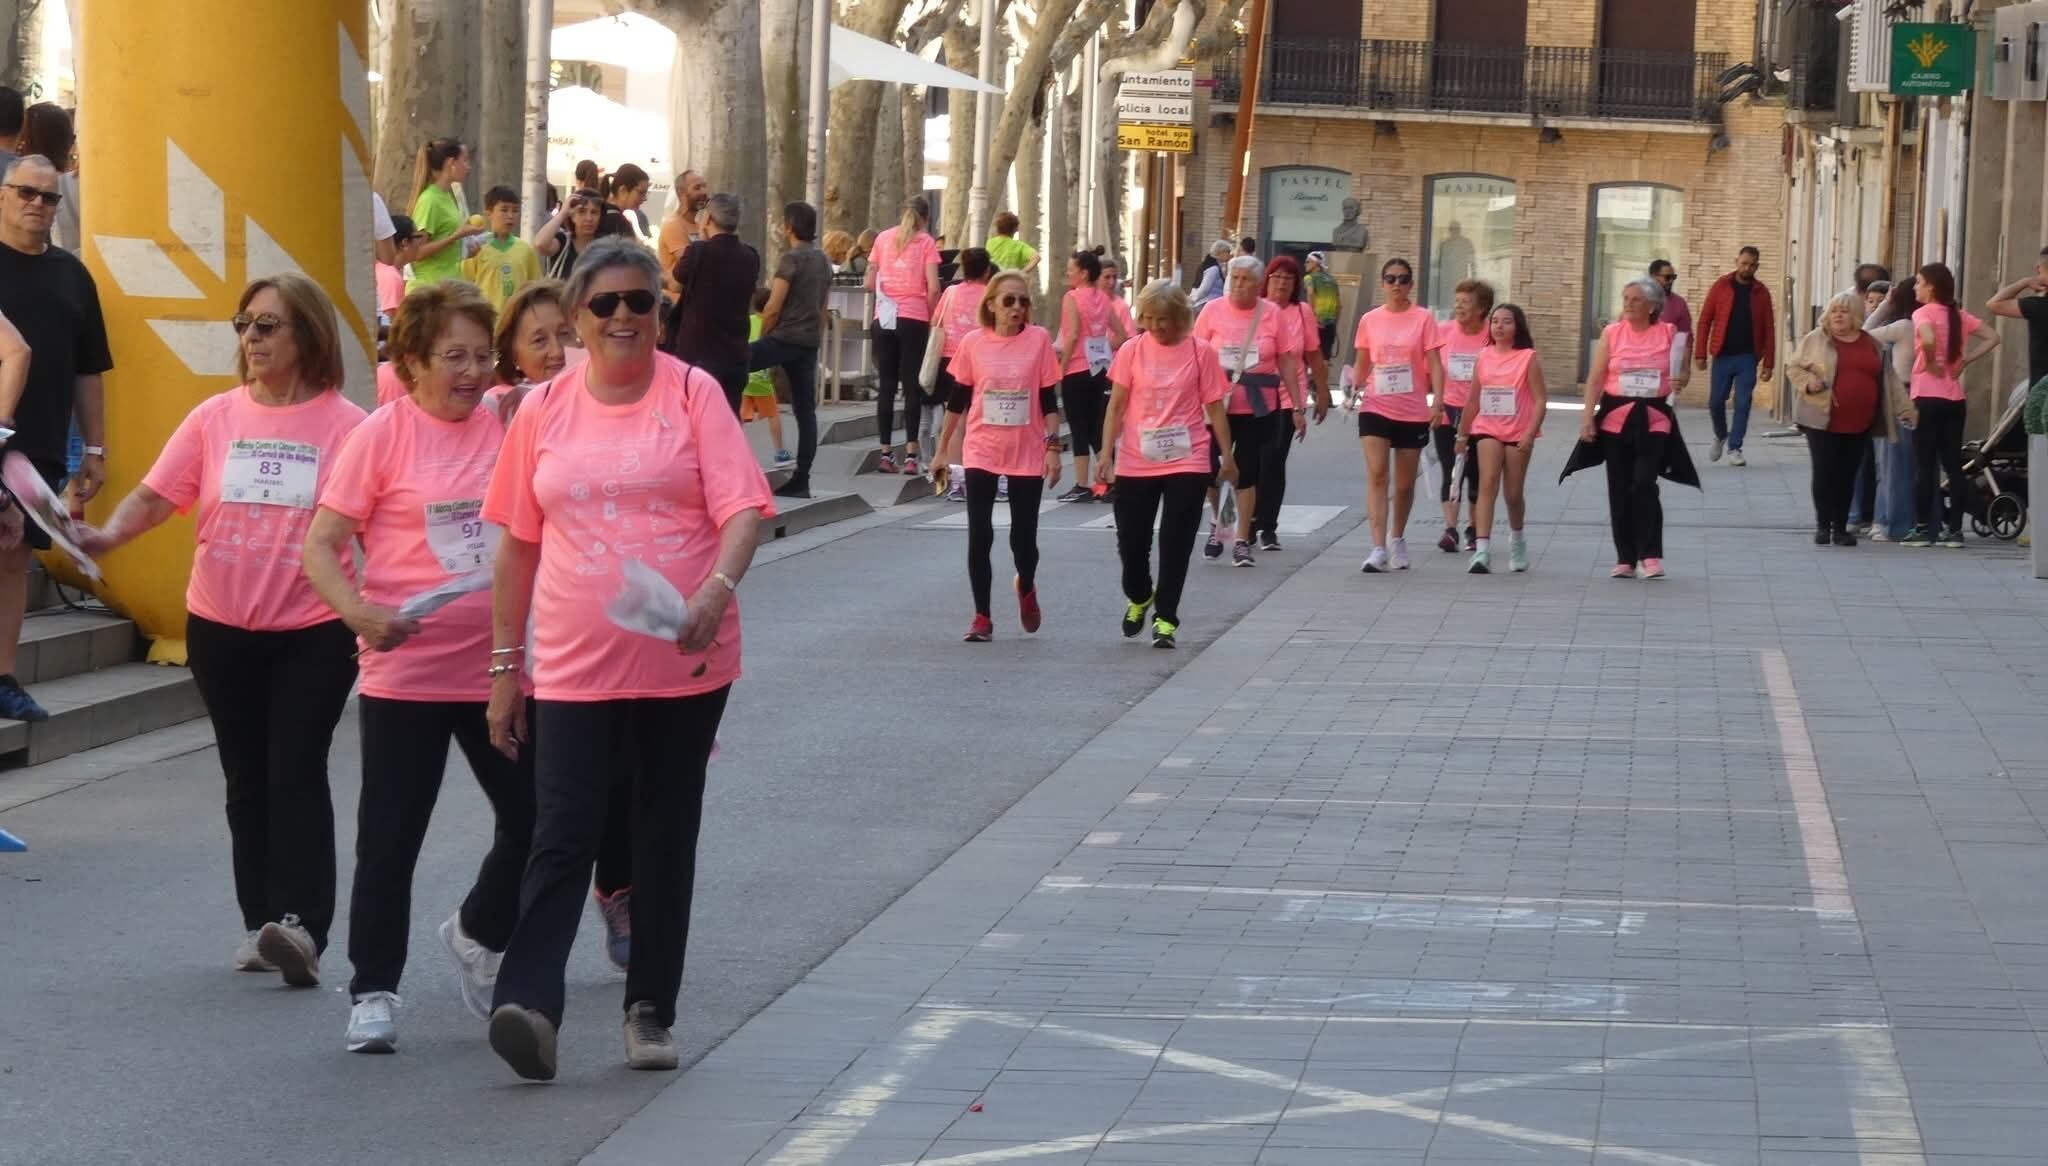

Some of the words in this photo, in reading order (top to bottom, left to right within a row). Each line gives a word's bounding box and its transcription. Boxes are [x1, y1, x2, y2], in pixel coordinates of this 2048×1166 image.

[1158, 104, 1190, 115] local
[1145, 129, 1168, 137] hotel
[1118, 135, 1141, 145] San
[999, 401, 1017, 410] 122
[259, 461, 282, 476] 83
[462, 522, 483, 540] 97
